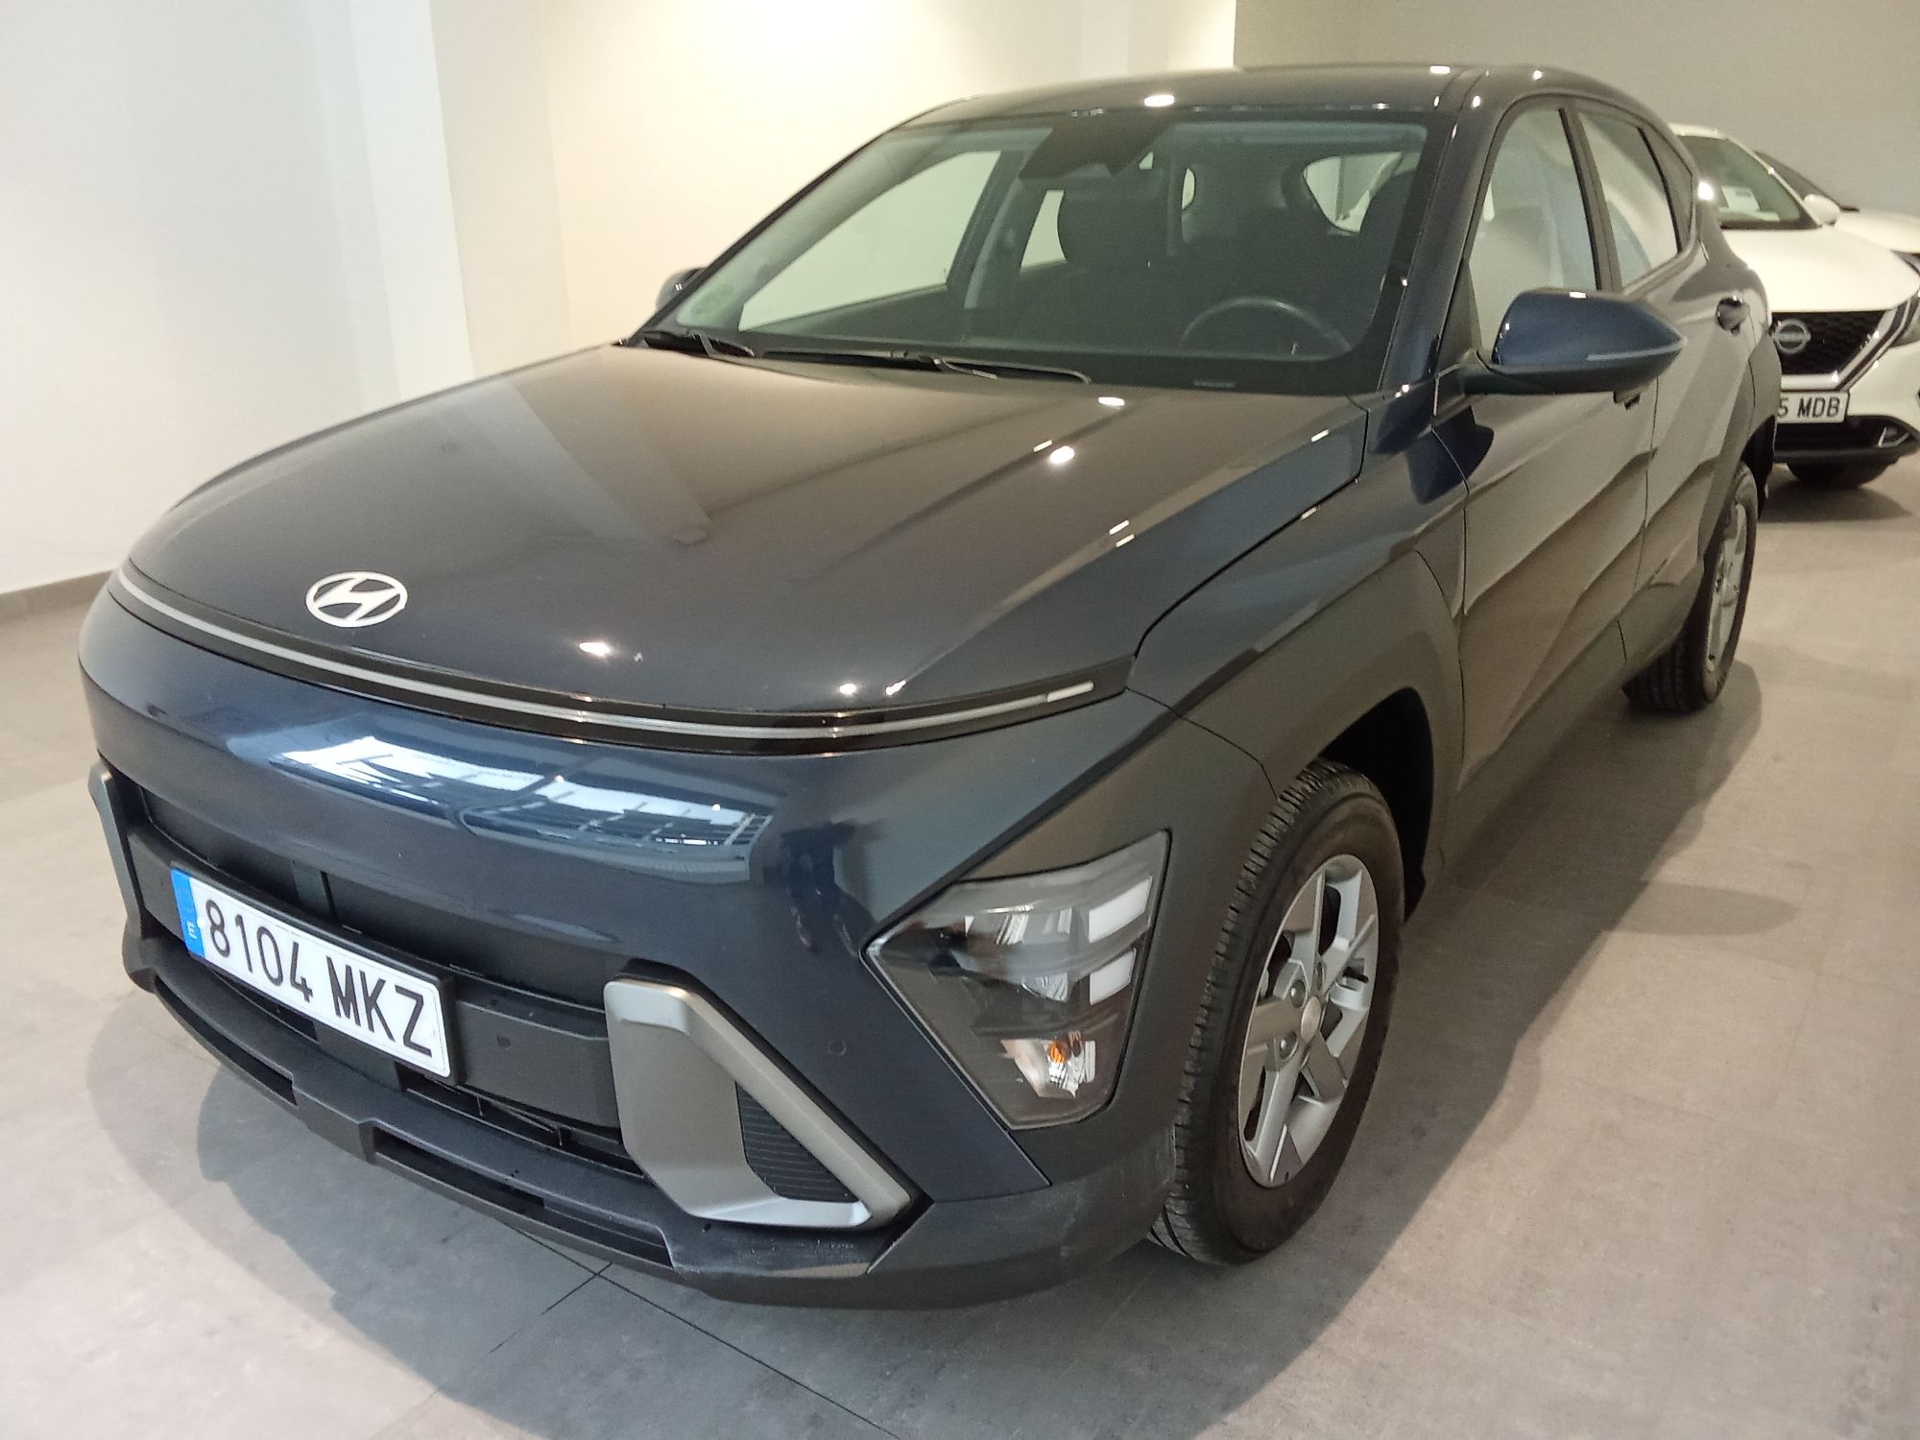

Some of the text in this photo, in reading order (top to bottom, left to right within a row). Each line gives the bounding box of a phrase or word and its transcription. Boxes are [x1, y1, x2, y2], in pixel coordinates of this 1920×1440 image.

[1797, 397, 1841, 418] MDB
[186, 921, 198, 940] E
[205, 899, 433, 1058] 8104 MKZ
